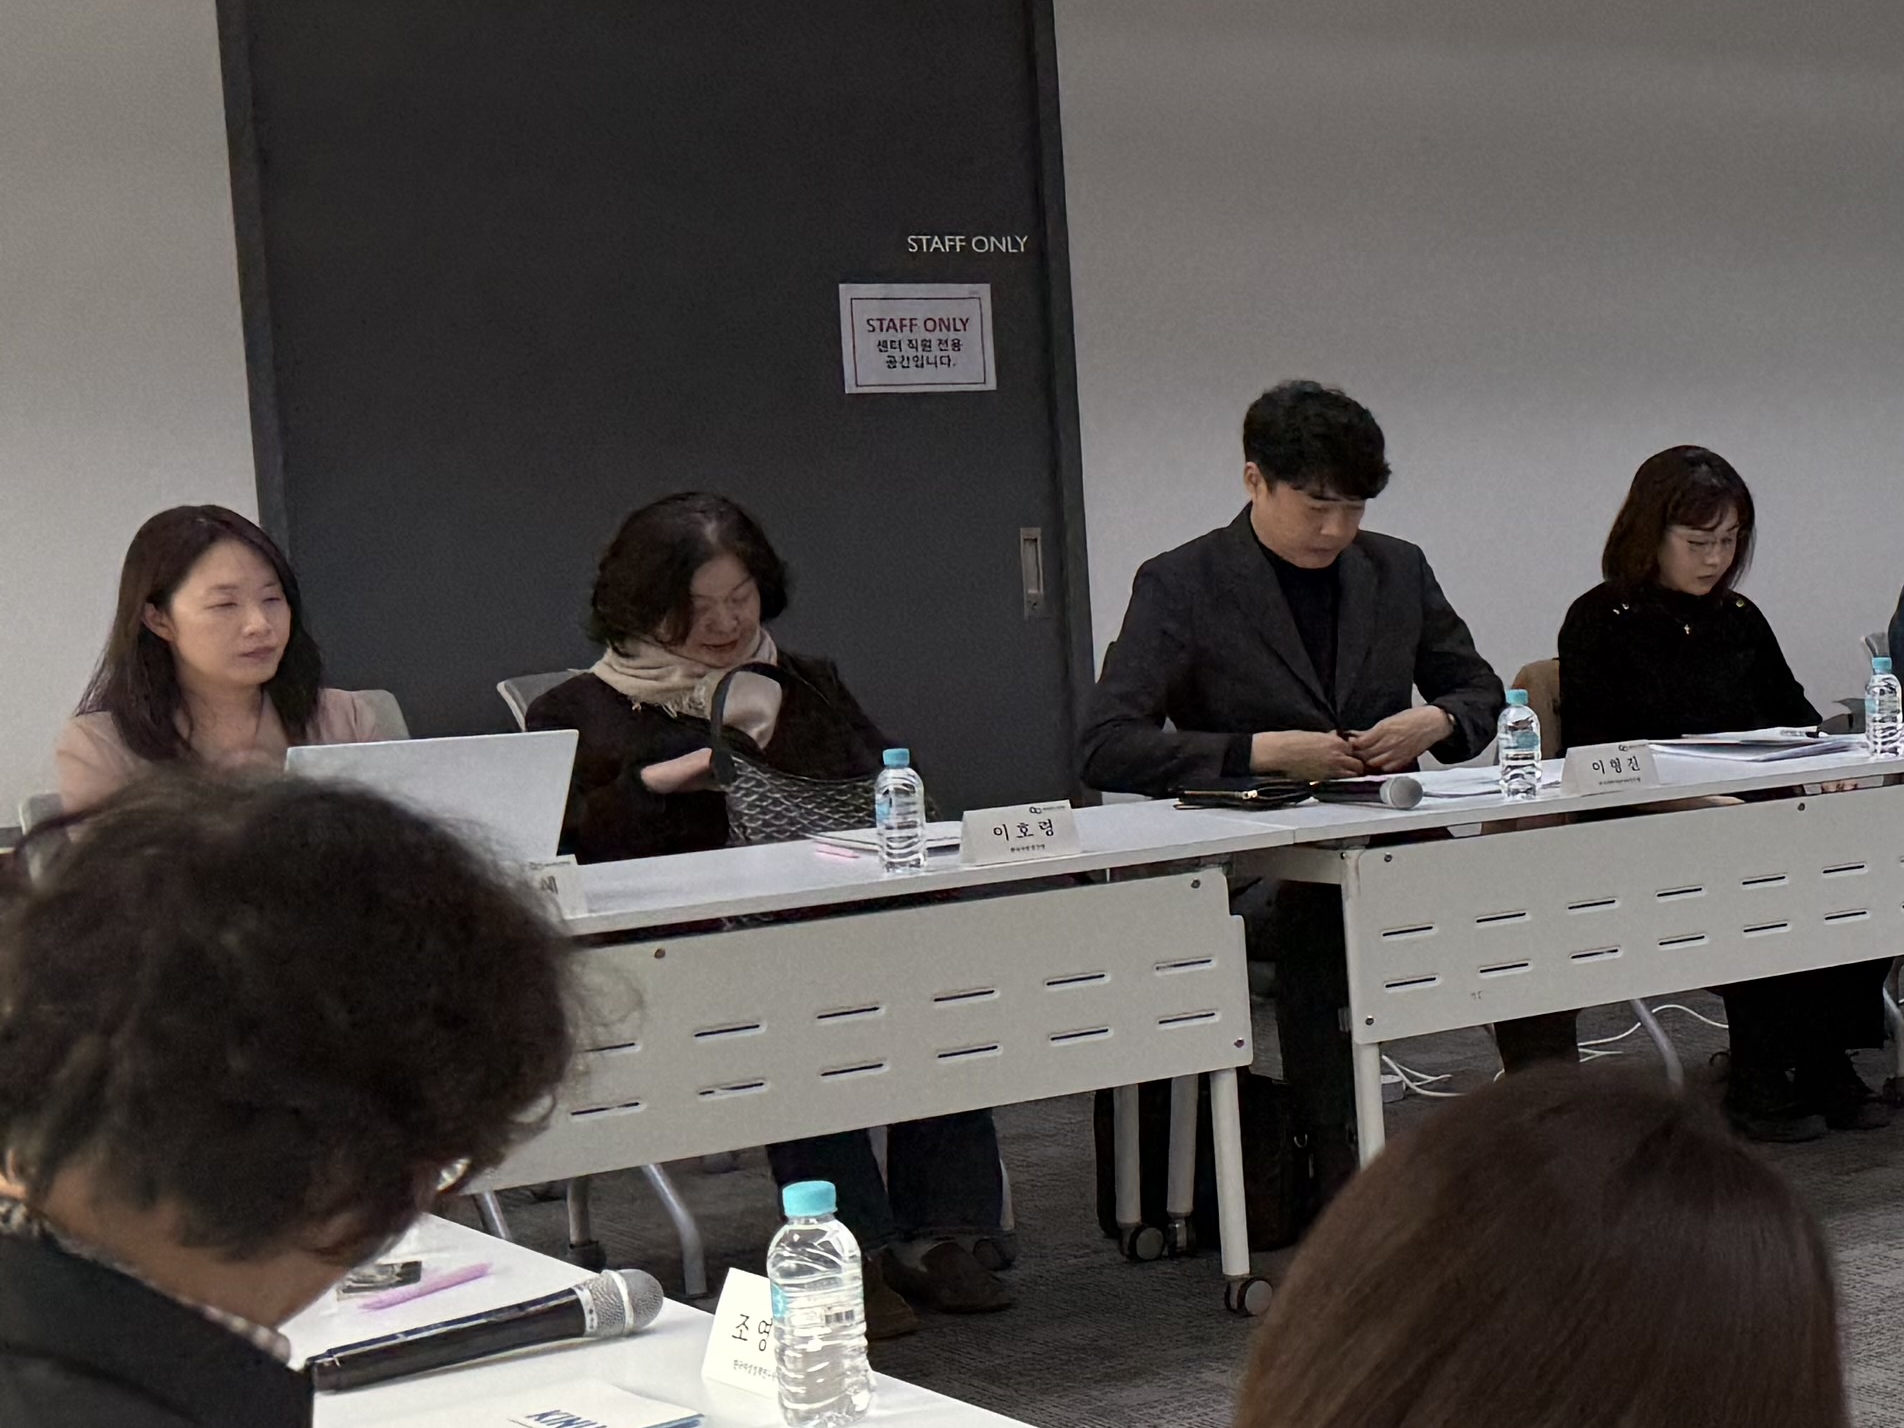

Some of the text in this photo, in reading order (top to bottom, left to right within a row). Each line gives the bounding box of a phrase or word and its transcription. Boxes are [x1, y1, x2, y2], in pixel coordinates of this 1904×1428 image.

[907, 235, 1029, 253] STAFF ONLY
[866, 317, 970, 333] STAFF ONLY
[877, 338, 963, 353] 센터 직원 전용
[732, 1314, 774, 1352] 조영
